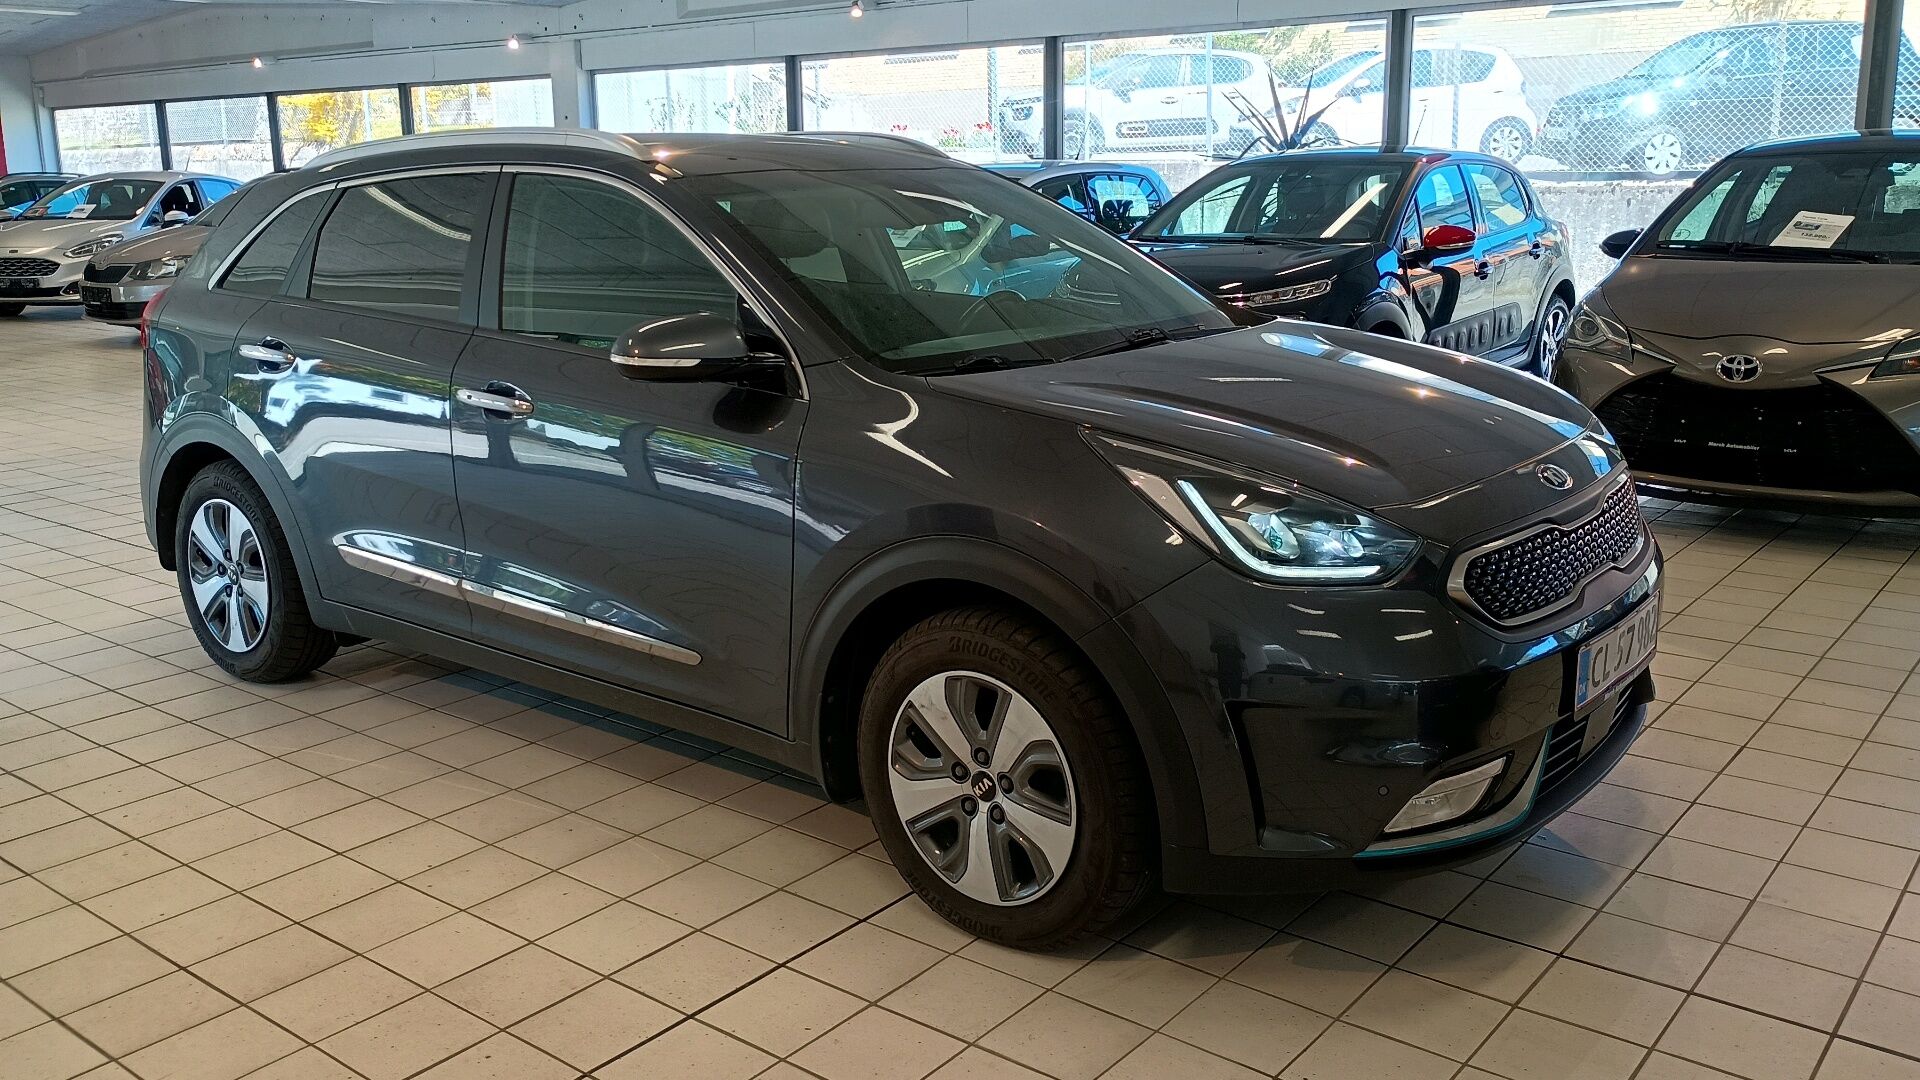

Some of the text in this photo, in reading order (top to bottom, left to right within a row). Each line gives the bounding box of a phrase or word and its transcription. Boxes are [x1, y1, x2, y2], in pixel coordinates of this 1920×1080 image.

[213, 477, 260, 521] BRIDGESTONE
[948, 636, 1056, 705] BRIDGESTONE
[1591, 642, 1611, 688] CL
[1613, 623, 1636, 672] 57
[973, 777, 993, 797] KIA
